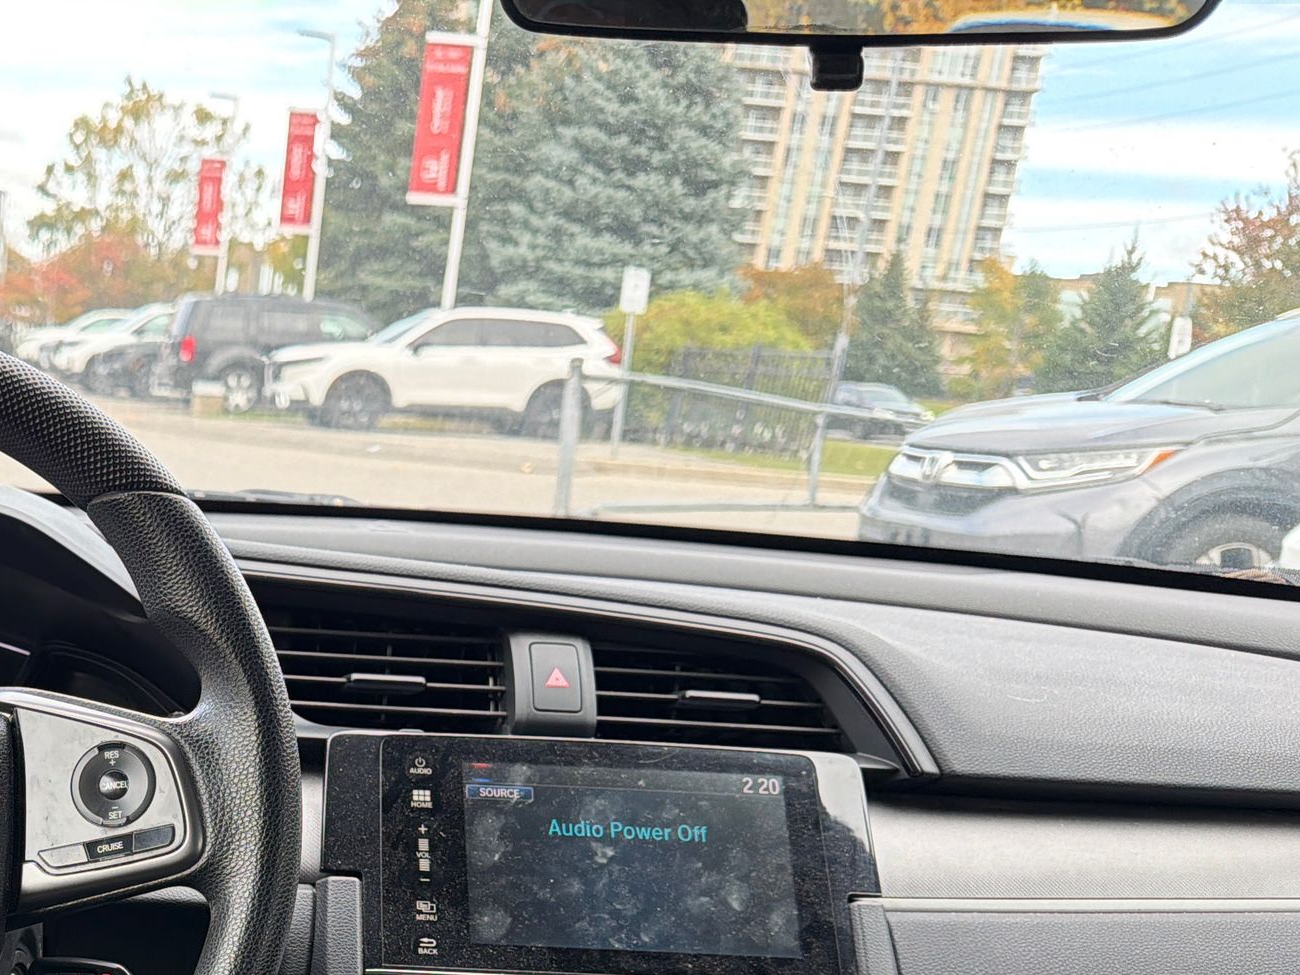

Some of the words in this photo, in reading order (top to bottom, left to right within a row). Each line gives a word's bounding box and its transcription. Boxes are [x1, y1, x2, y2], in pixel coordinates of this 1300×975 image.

[104, 751, 119, 759] RES
[409, 767, 433, 775] AUDIO
[101, 780, 129, 790] CANCEL
[479, 788, 521, 798] SOURCE
[410, 801, 433, 809] HOME
[108, 811, 122, 819] SET
[548, 818, 604, 838] Audio
[610, 821, 672, 841] Power
[677, 824, 709, 843] Off
[97, 841, 124, 854] CRUISE
